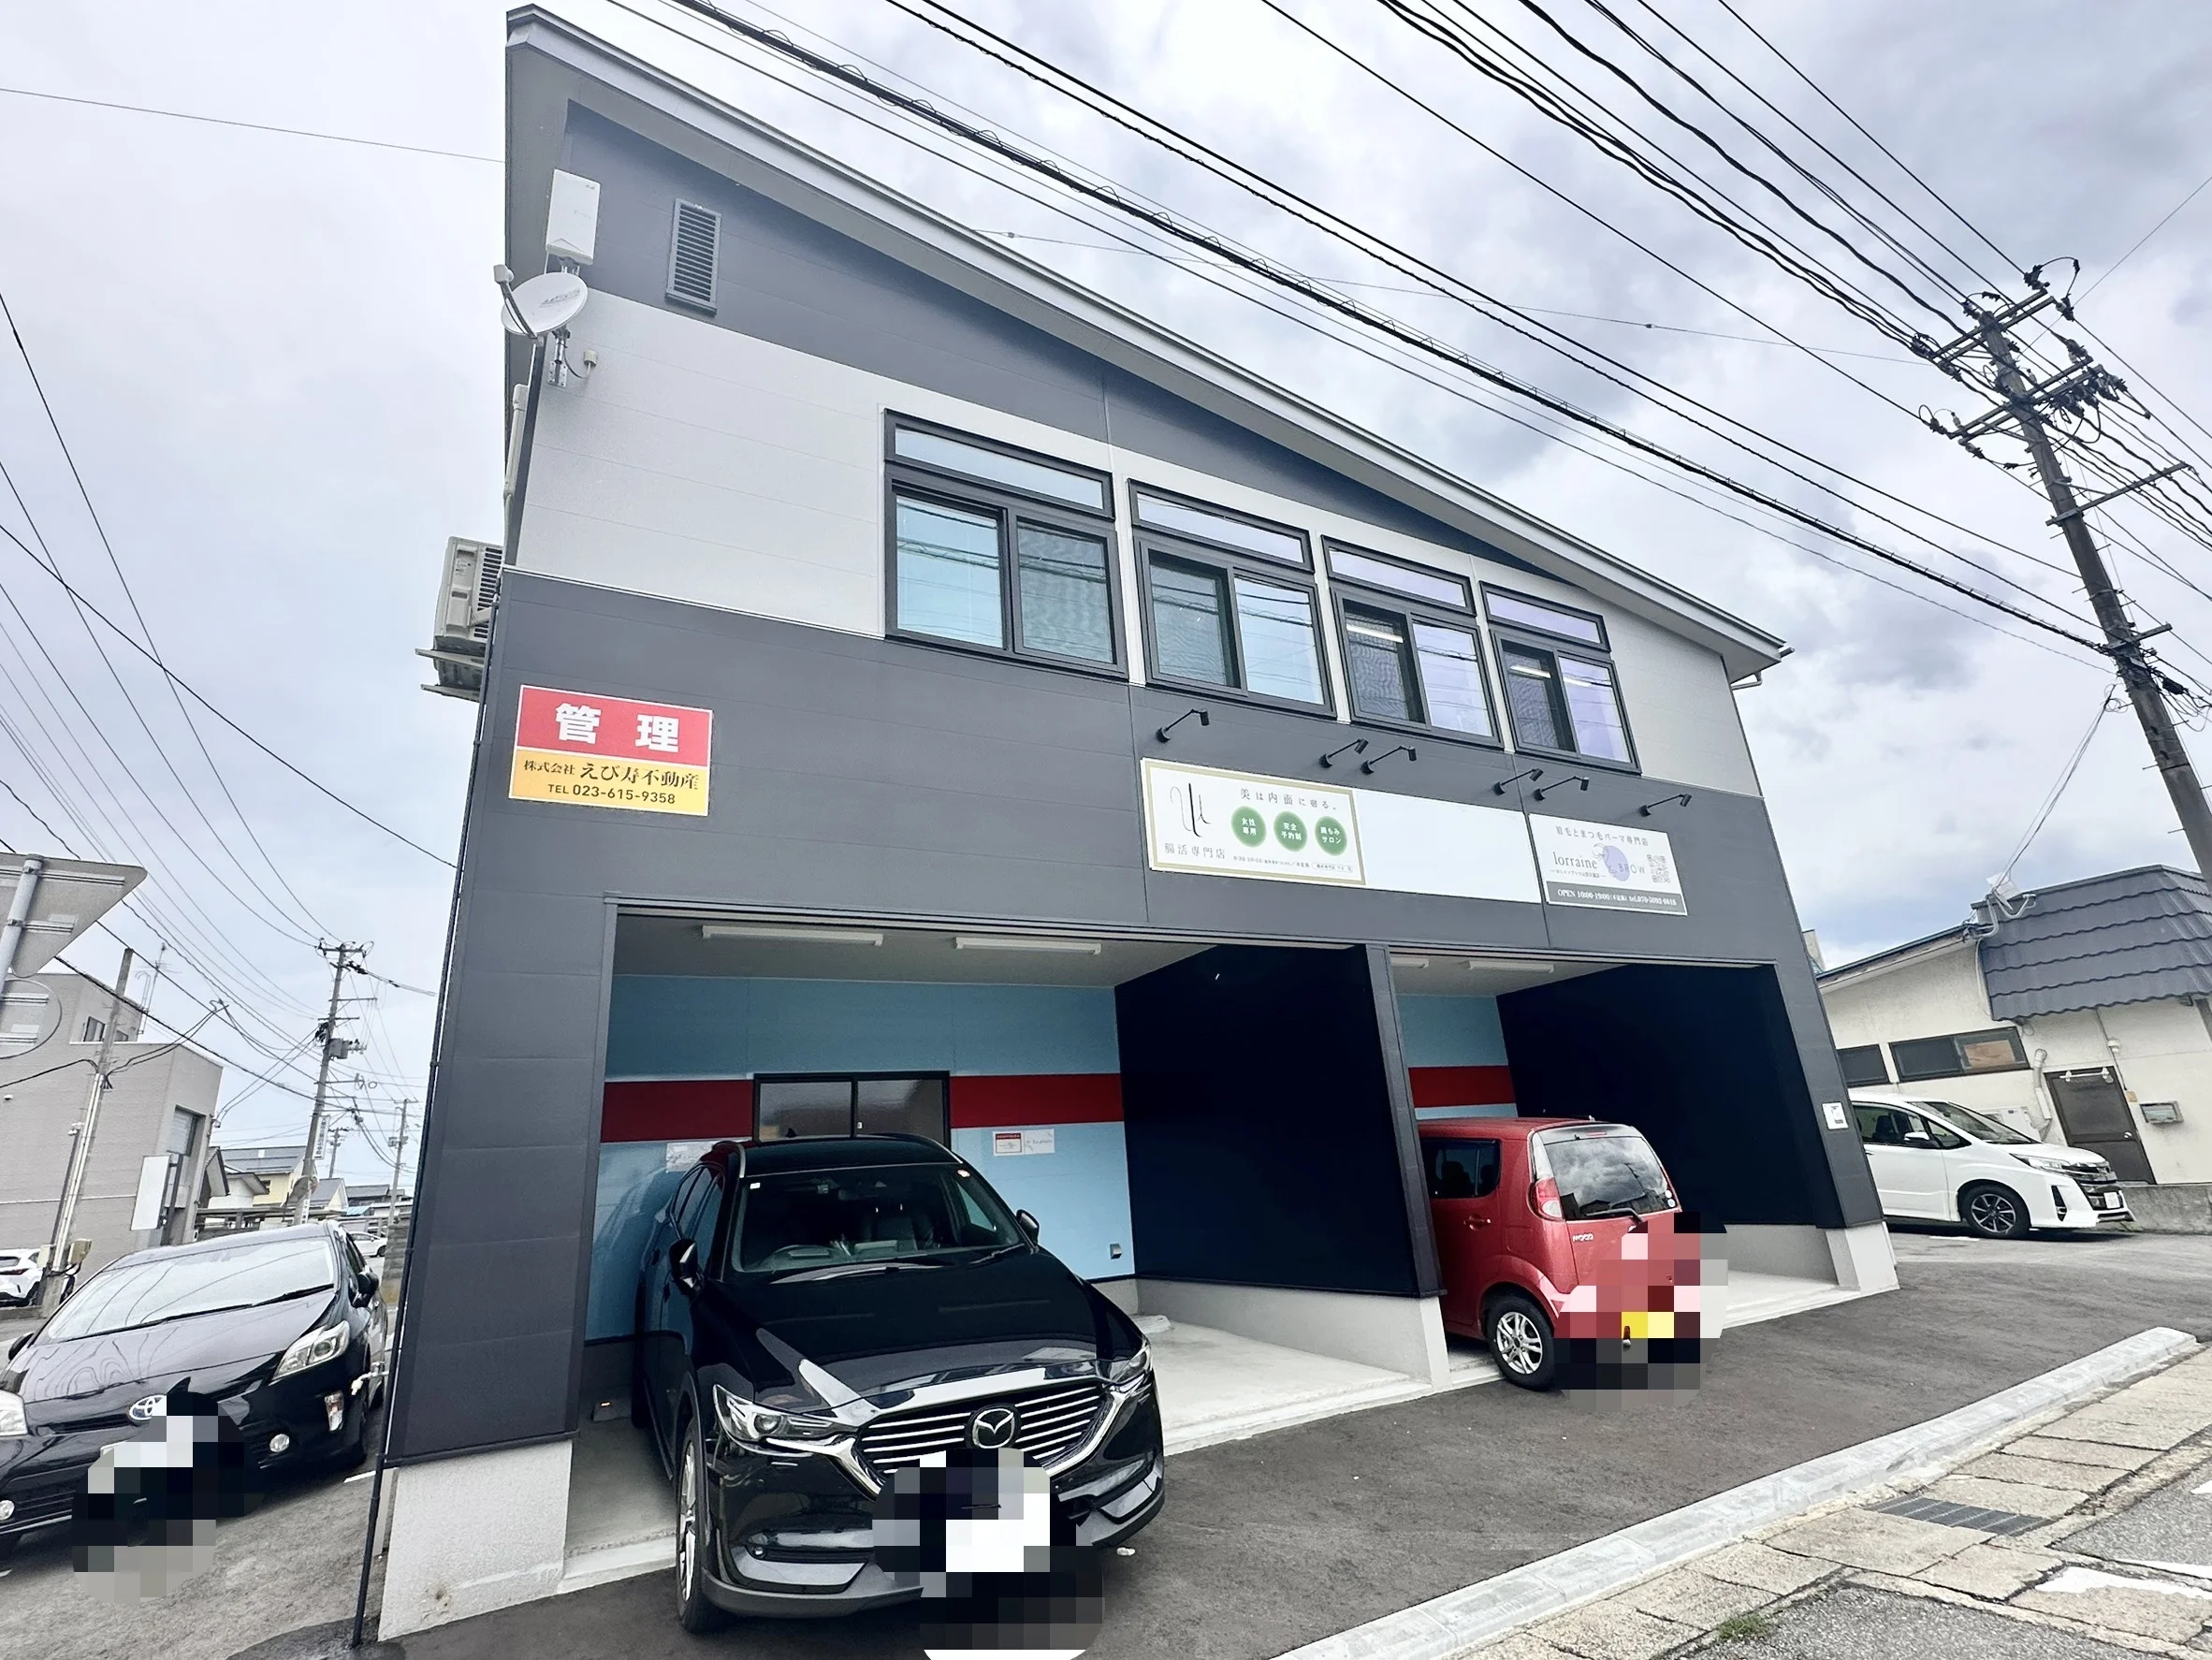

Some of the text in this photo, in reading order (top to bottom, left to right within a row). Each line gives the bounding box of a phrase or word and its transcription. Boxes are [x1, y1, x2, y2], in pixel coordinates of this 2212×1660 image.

[556, 703, 679, 753] 管理
[547, 783, 676, 805] TEL 023-615-9358
[1553, 852, 1598, 869] lorraine
[1557, 888, 1576, 897] OPEN
